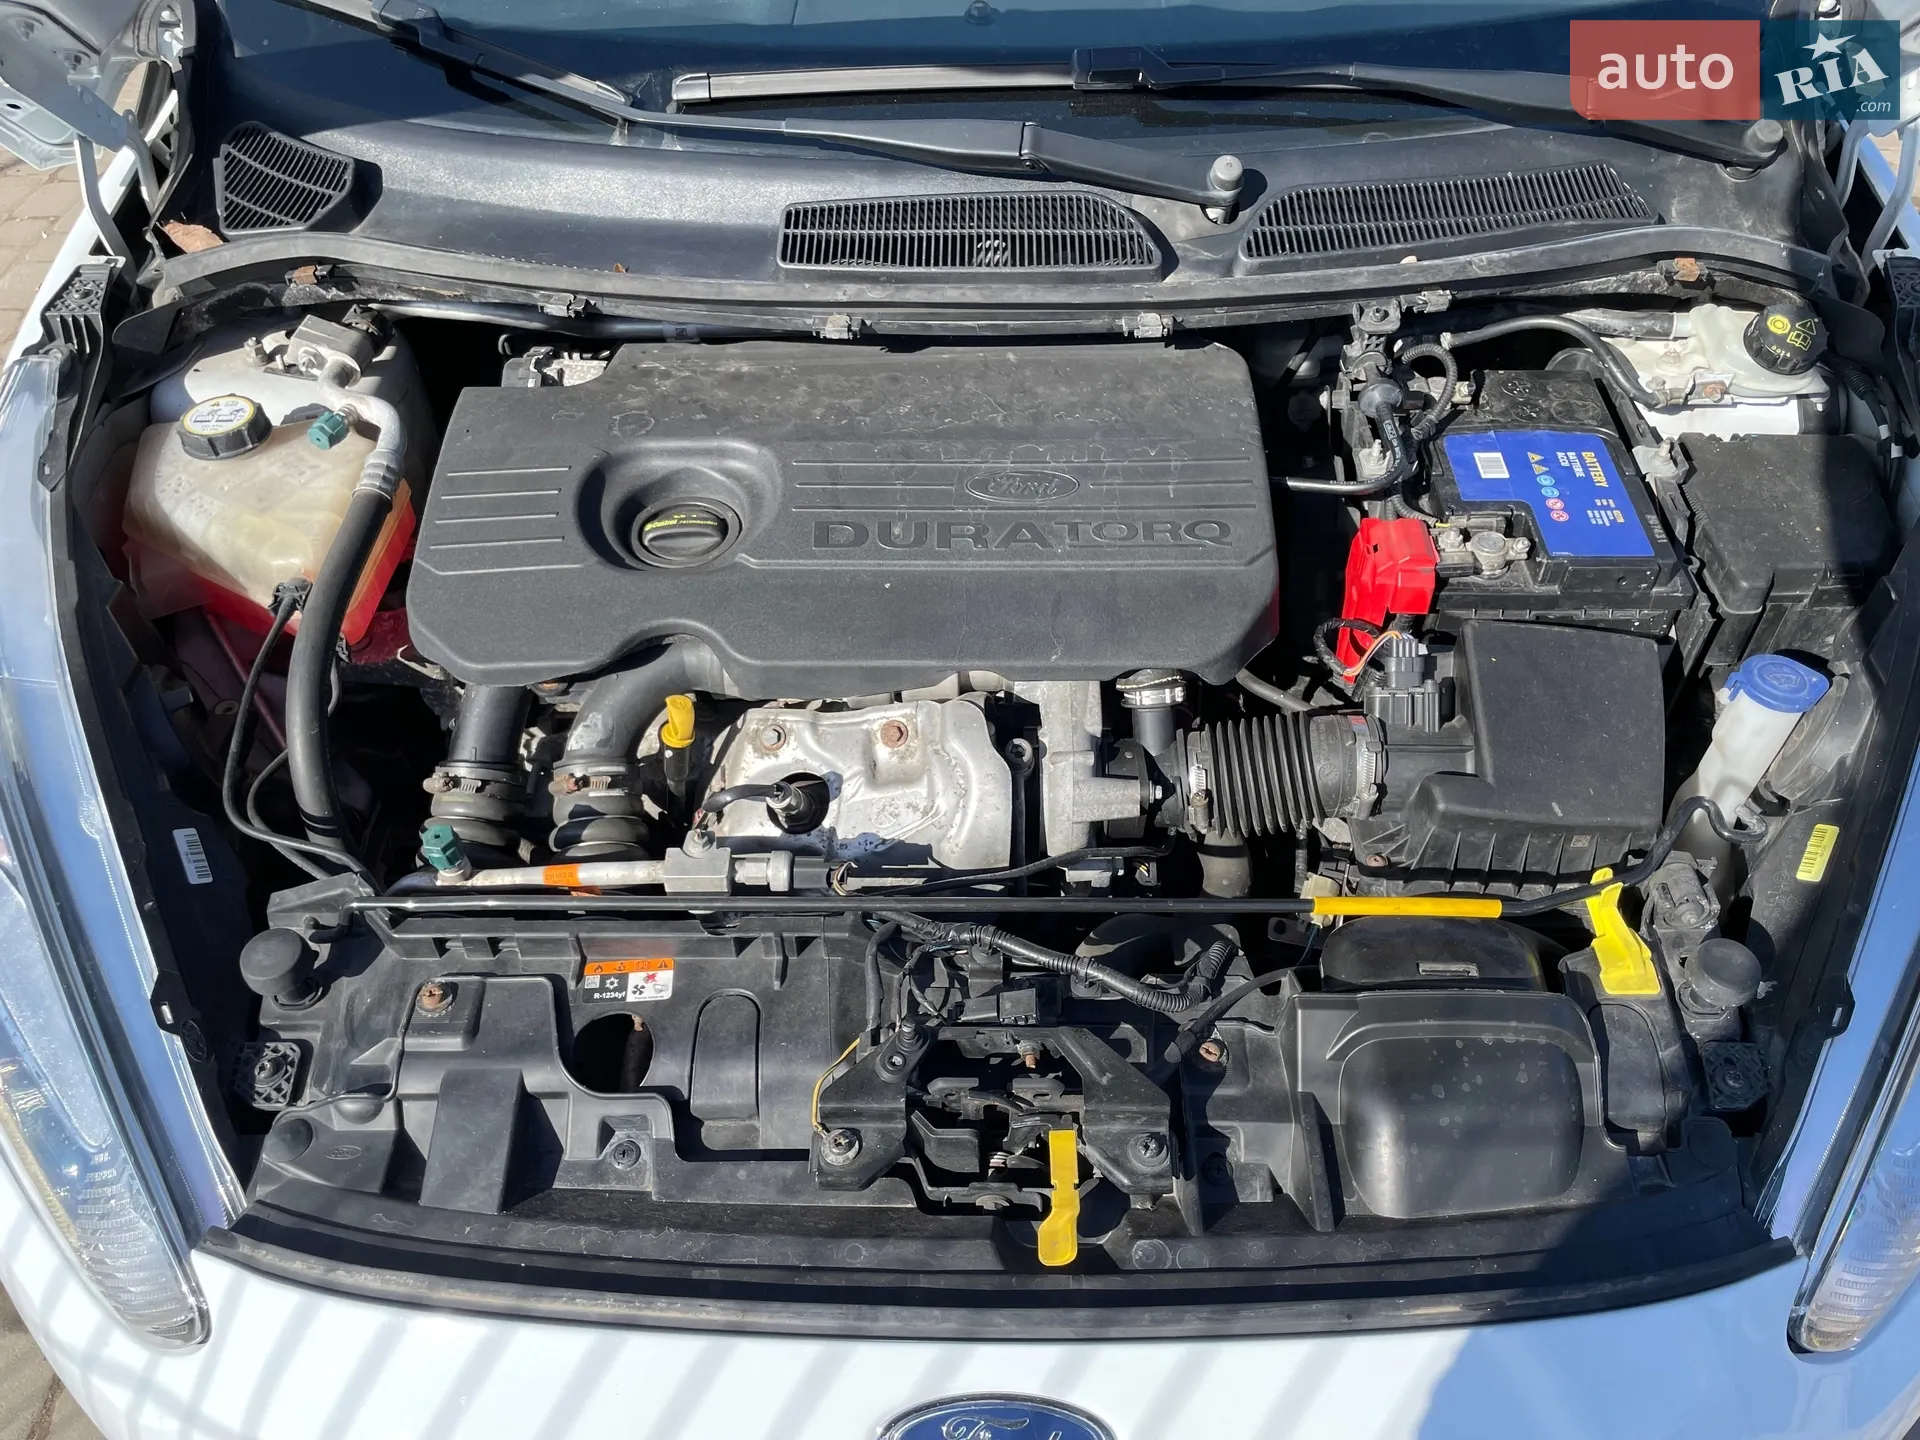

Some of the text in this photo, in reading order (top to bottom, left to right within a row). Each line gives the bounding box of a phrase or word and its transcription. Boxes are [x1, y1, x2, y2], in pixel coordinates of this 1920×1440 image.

[1556, 452, 1570, 467] ACCU
[1567, 452, 1585, 478] BATTERIE
[1581, 452, 1609, 488] BATTERY
[986, 474, 1058, 495] Ford
[812, 519, 1233, 549] DURATORQ
[593, 991, 626, 999] R-1234yf
